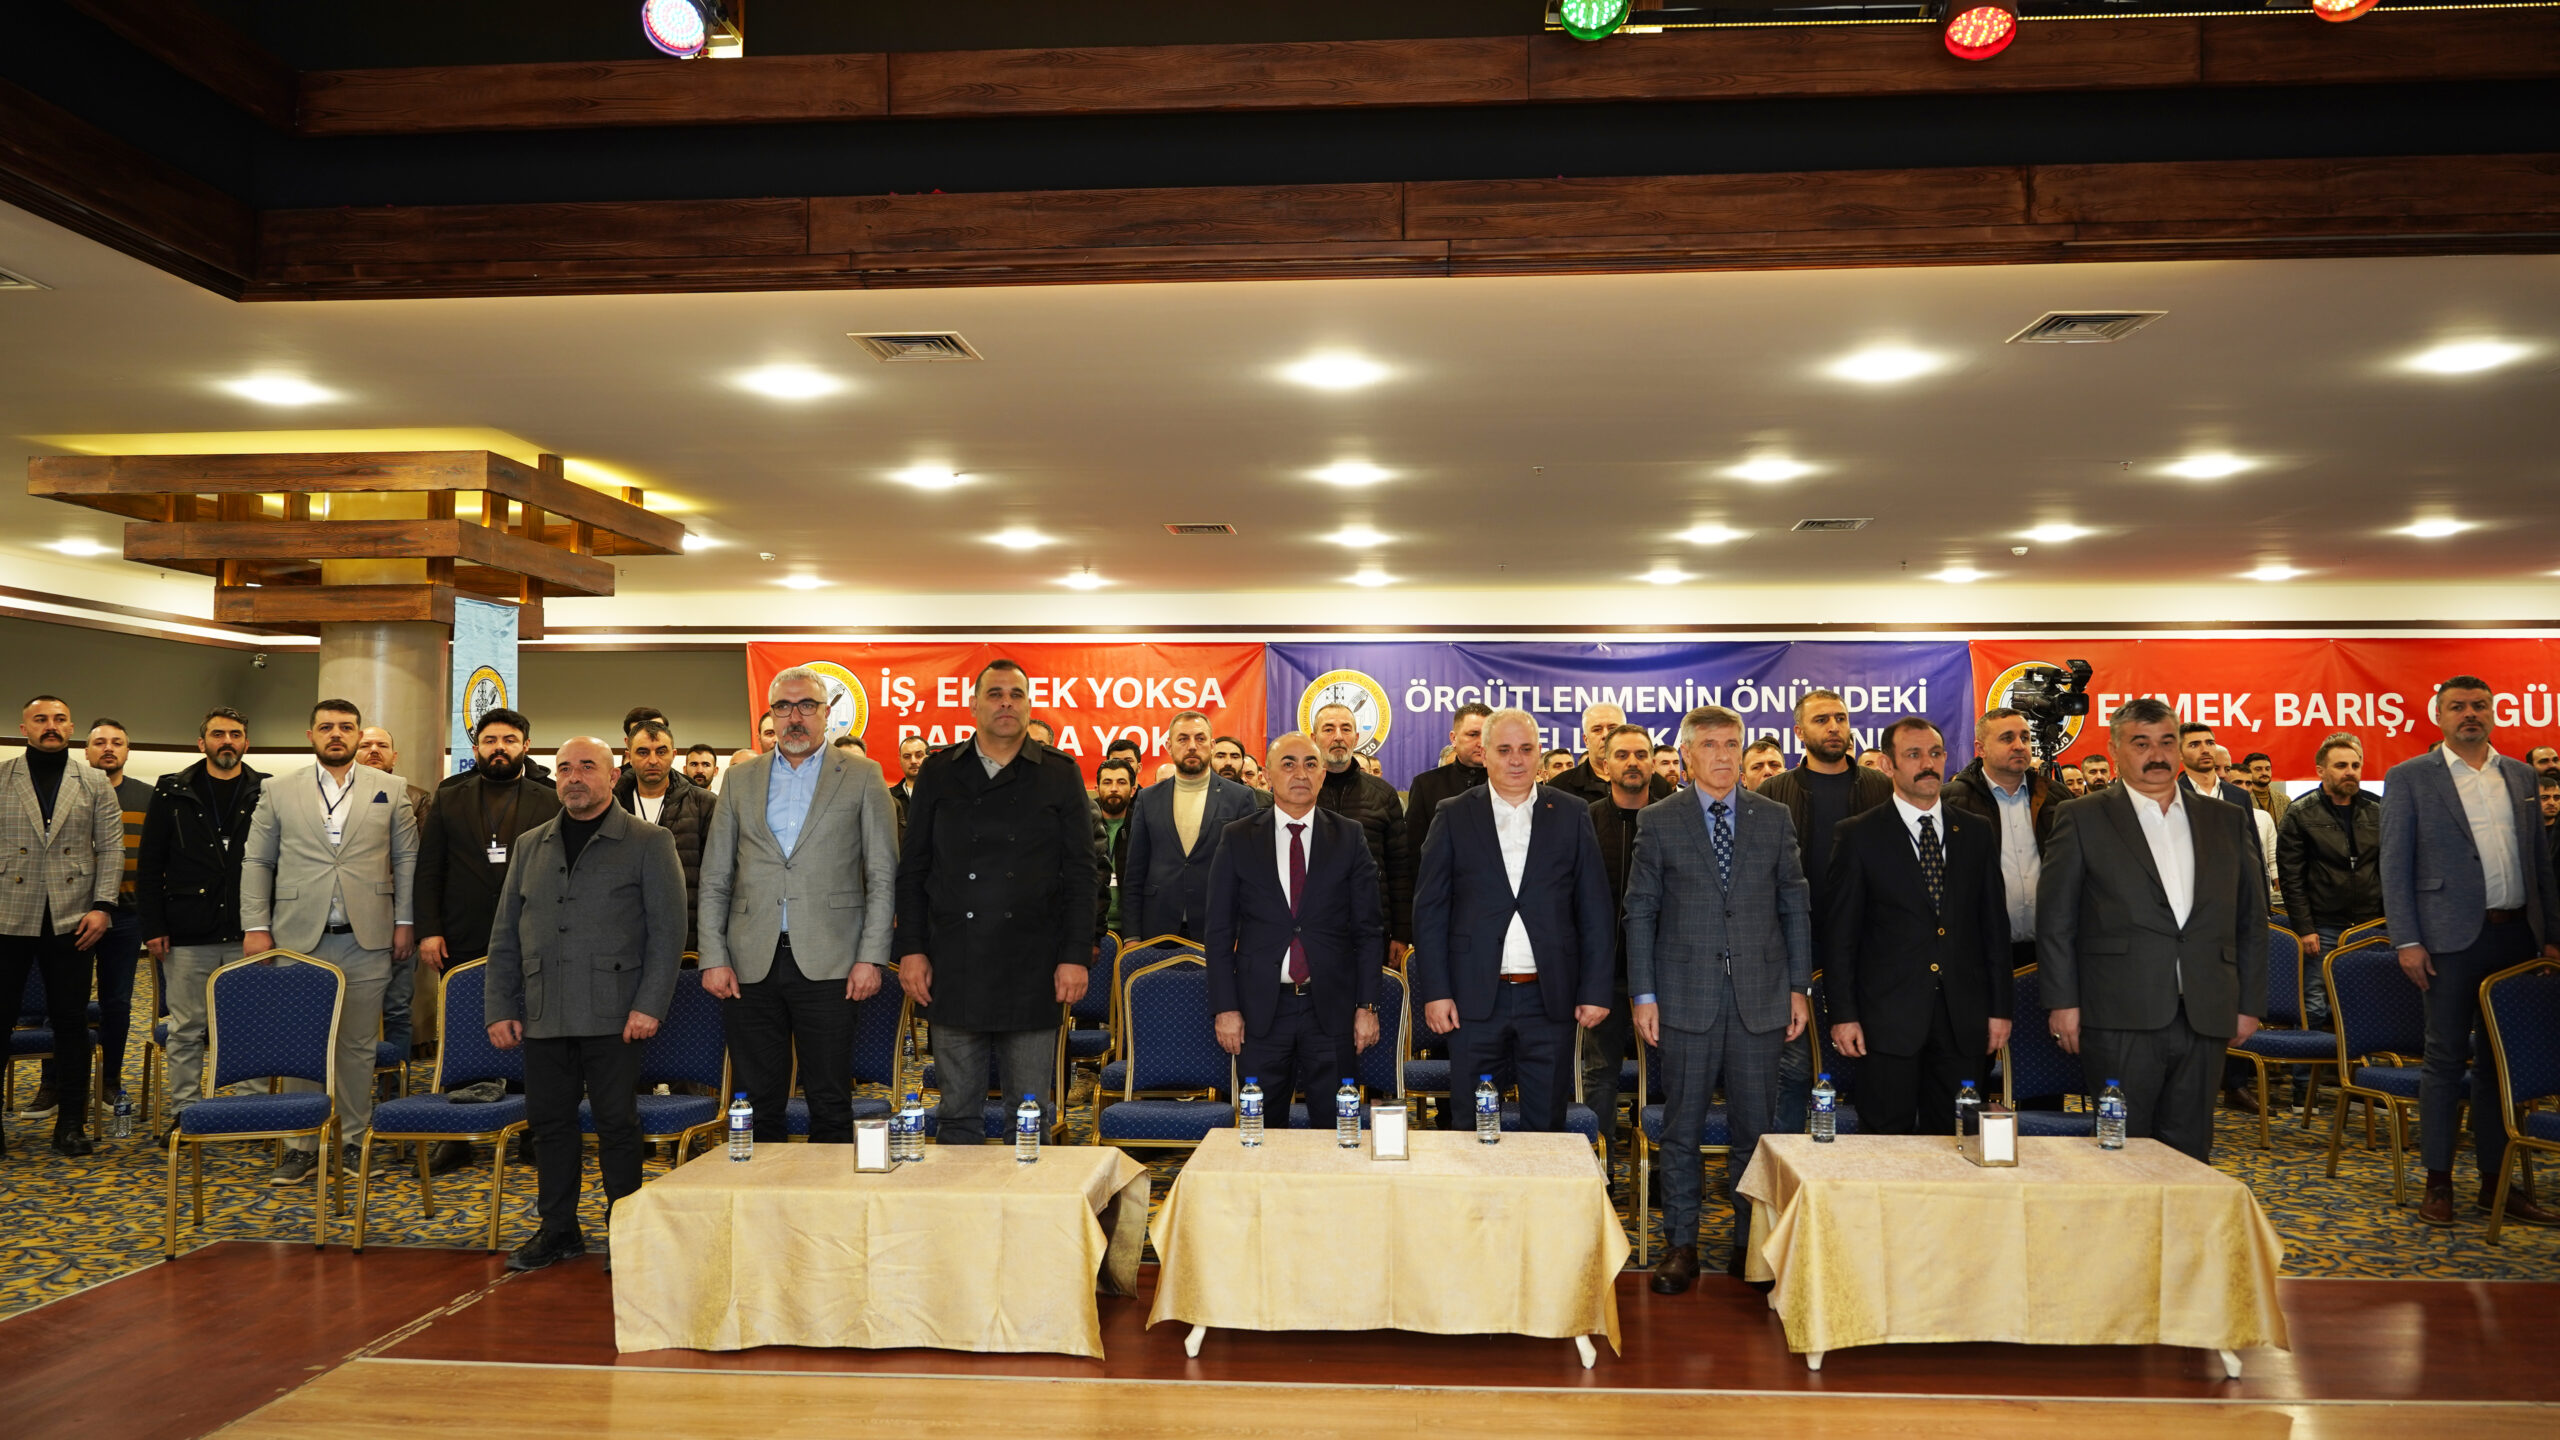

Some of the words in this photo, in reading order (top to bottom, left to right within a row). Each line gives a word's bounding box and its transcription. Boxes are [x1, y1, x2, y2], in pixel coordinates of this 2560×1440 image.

[881, 668, 925, 716] İŞ,
[937, 677, 1078, 708] EKEK
[1086, 677, 1227, 709] YOKSA
[1405, 678, 1722, 713] ÖRGÜTLENMENİN
[1731, 678, 1927, 713] ÖNÜDEKİ
[2097, 693, 2262, 733] EMEK,
[2274, 692, 2415, 737] BARIŞ,
